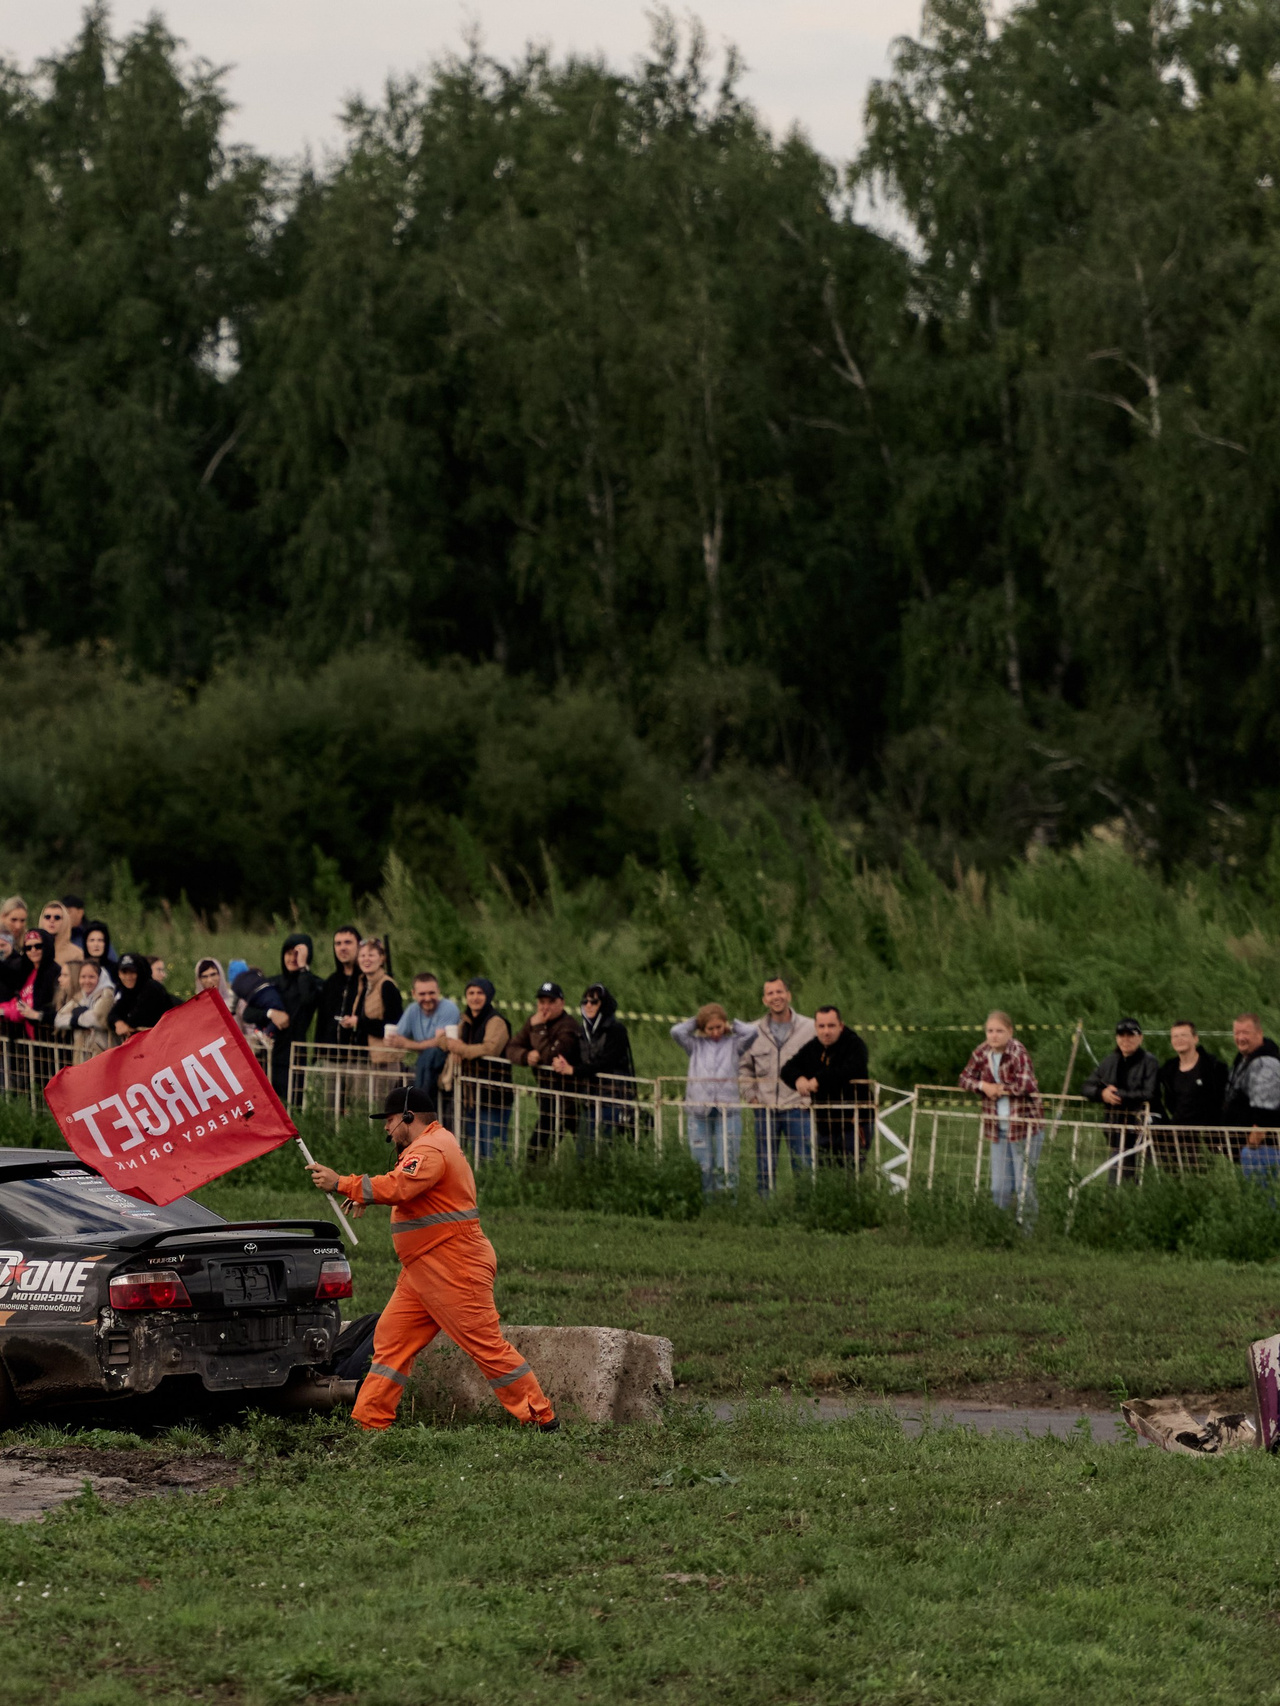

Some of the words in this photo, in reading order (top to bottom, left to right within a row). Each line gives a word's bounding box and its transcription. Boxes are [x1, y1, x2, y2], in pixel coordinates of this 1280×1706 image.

[148, 1256, 177, 1264] TOURER
[179, 1254, 185, 1262] V
[11, 1292, 84, 1303] MOTORSPORT
[0, 1303, 29, 1311] тюнинг
[29, 1303, 81, 1313] автомобилей
